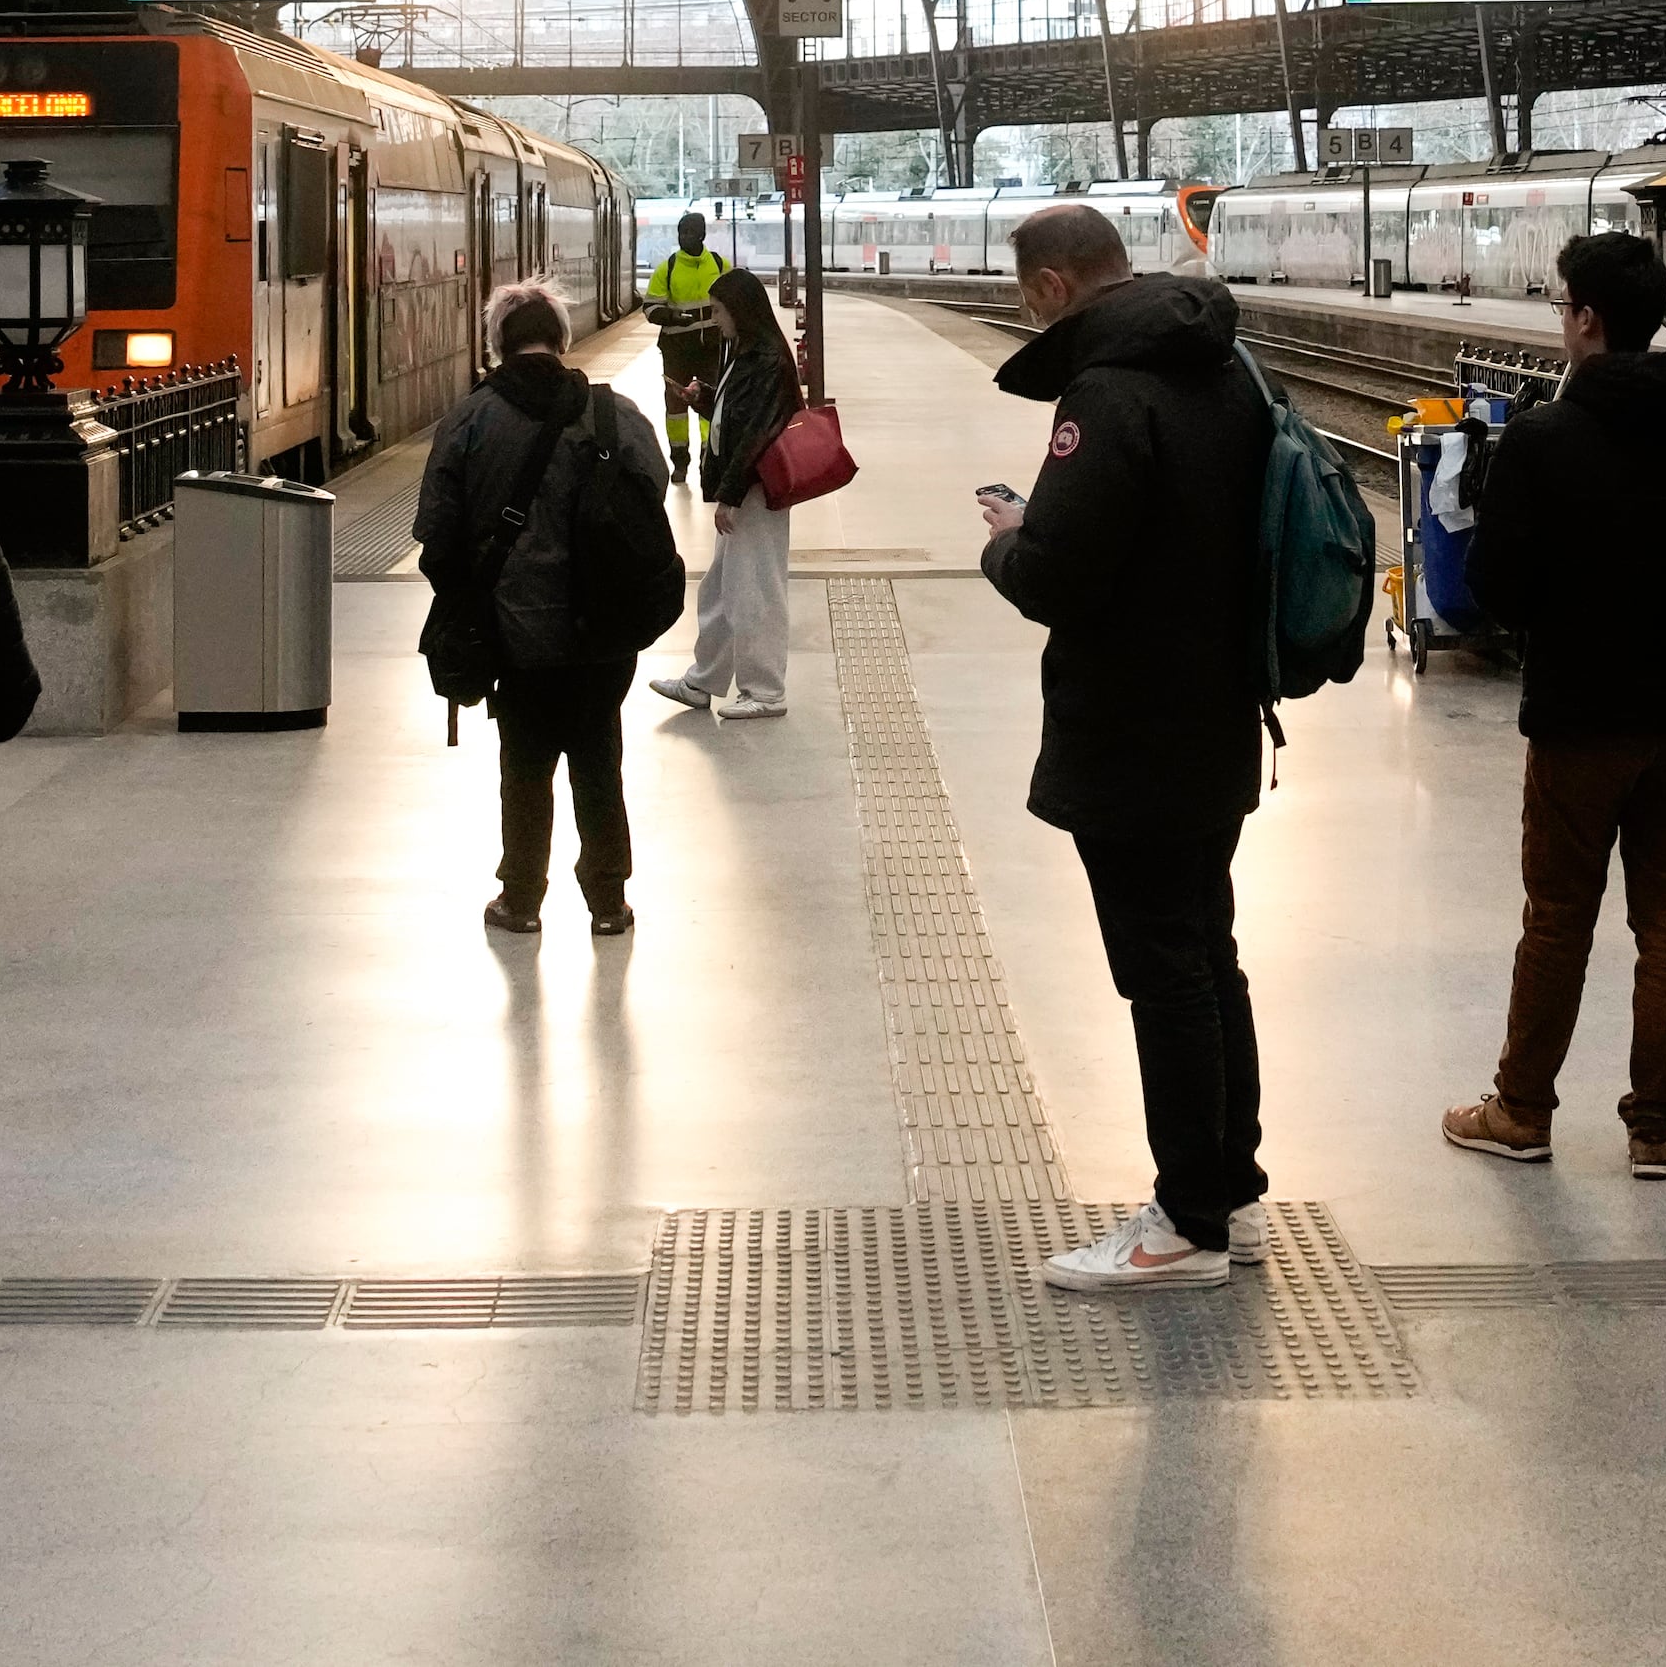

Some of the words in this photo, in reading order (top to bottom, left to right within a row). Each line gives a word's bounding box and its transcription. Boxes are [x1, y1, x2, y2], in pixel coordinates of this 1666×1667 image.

[782, 11, 837, 23] SECTOR
[749, 141, 762, 160] 7
[779, 139, 793, 156] B
[1329, 136, 1342, 154] 5
[1358, 134, 1372, 150] B
[1389, 135, 1404, 153] 4
[714, 182, 722, 193] 5
[745, 181, 753, 192] 4
